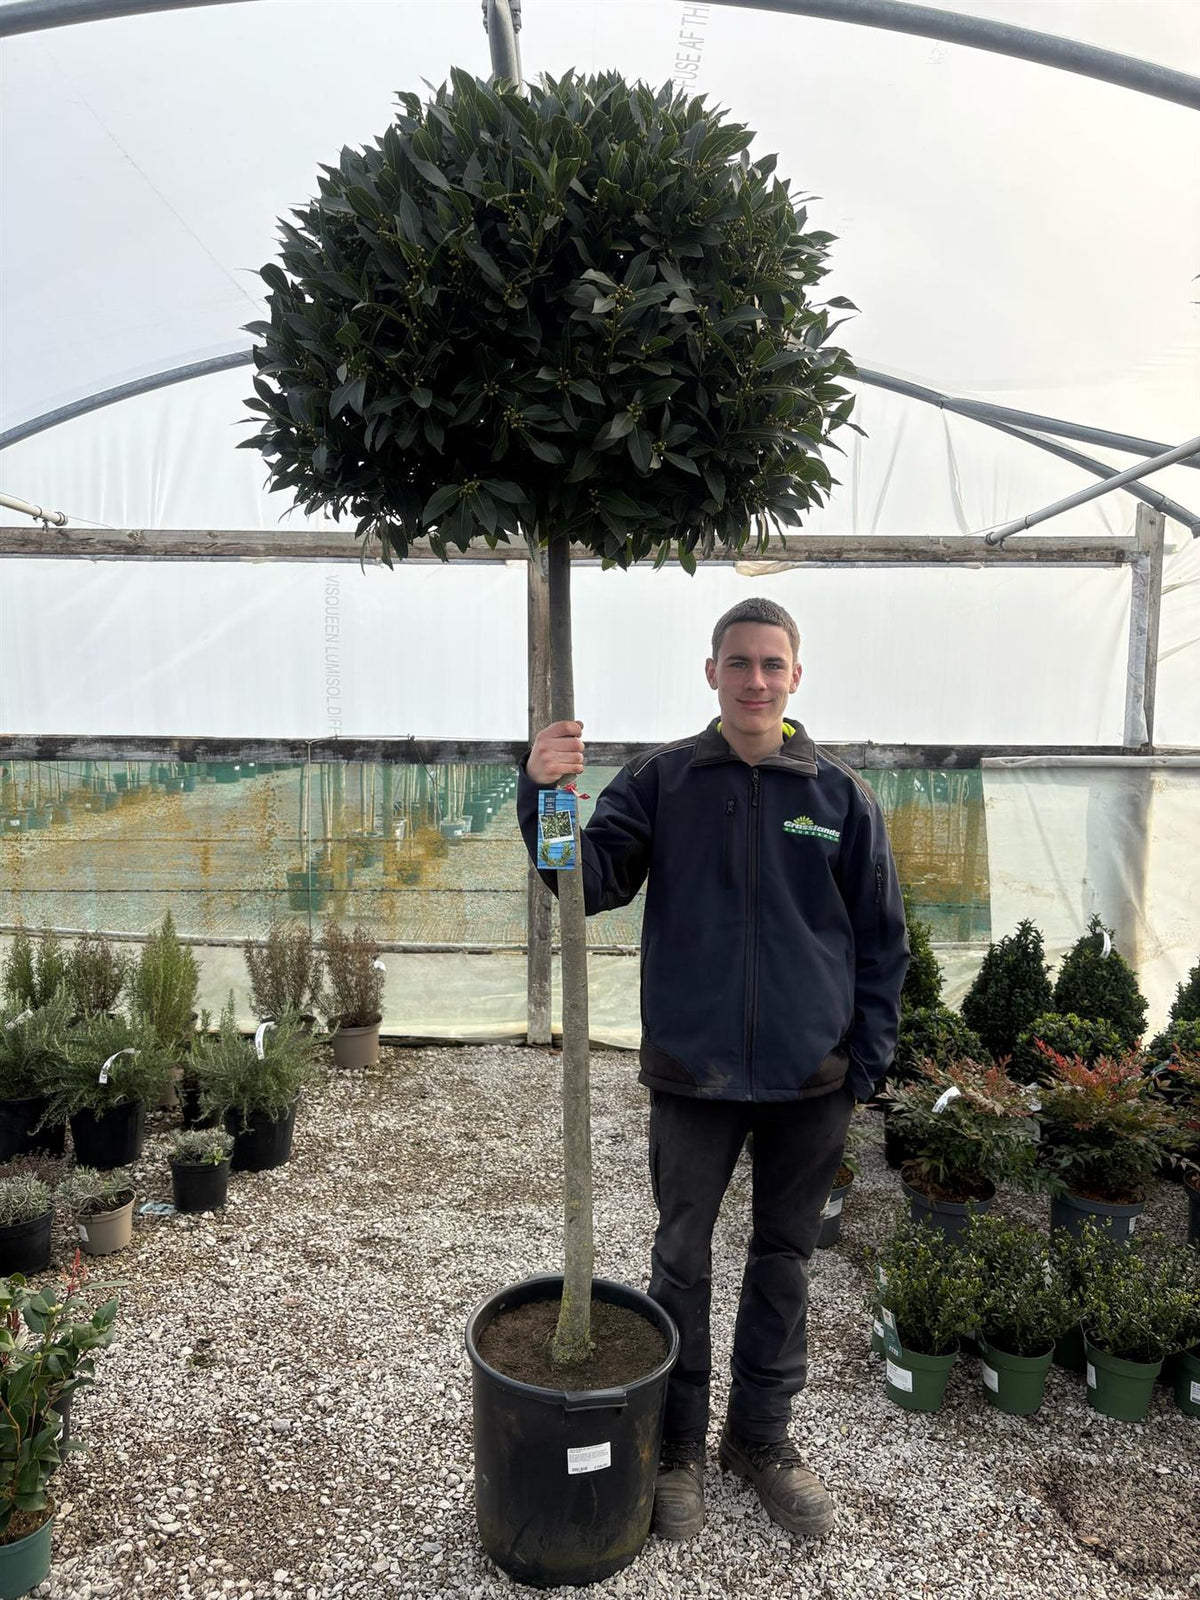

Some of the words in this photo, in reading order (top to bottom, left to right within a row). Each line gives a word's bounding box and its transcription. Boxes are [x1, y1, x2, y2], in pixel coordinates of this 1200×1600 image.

[678, 30, 705, 51] AF
[673, 52, 701, 96] FUSE
[324, 574, 340, 643] VISQUEEN
[325, 646, 341, 703] LUMISOL
[783, 820, 841, 838] Grasslands
